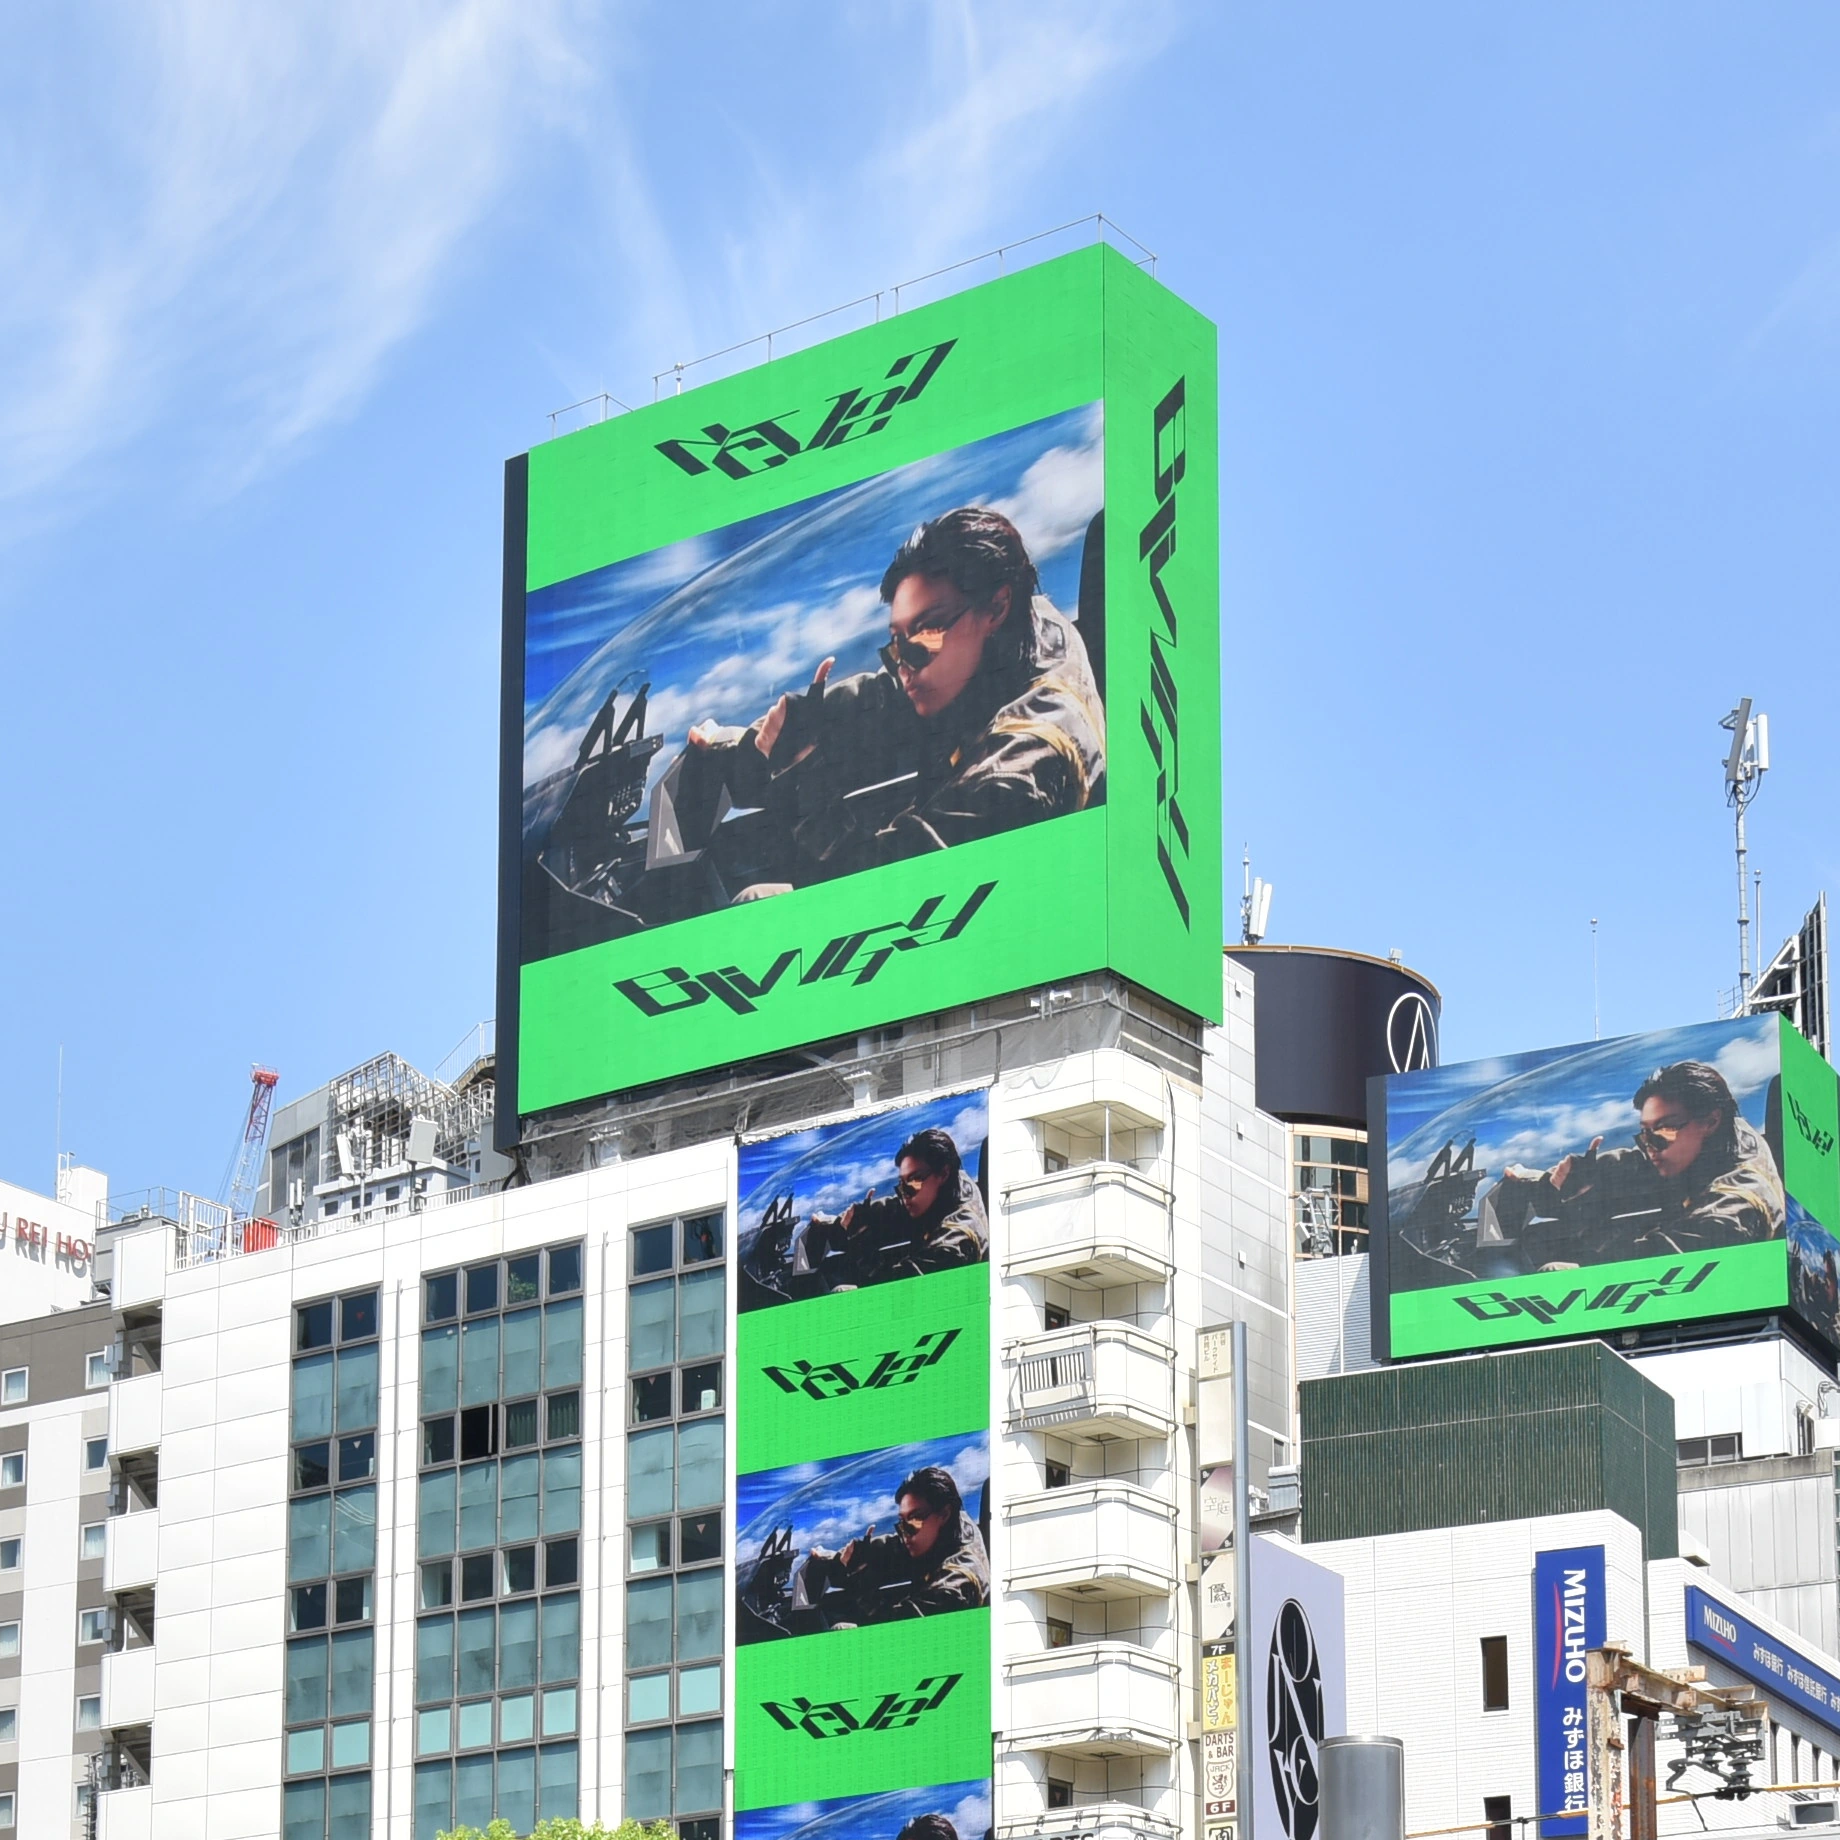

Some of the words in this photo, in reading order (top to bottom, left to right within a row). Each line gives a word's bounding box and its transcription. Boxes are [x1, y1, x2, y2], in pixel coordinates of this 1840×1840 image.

[17, 1217, 47, 1248] REI
[1564, 1568, 1587, 1683] MIZUHO
[1703, 1604, 1737, 1643] MIZUHO
[1210, 1645, 1227, 1656] 7F
[1753, 1642, 1784, 1678] みずほ銀行
[1220, 1656, 1234, 1725] まーじゃん
[1206, 1733, 1234, 1747] DARTS
[1208, 1750, 1214, 1759] &
[1216, 1745, 1234, 1758] BAR
[1210, 1764, 1232, 1773] JACK
[1563, 1706, 1587, 1812] みずほ銀行
